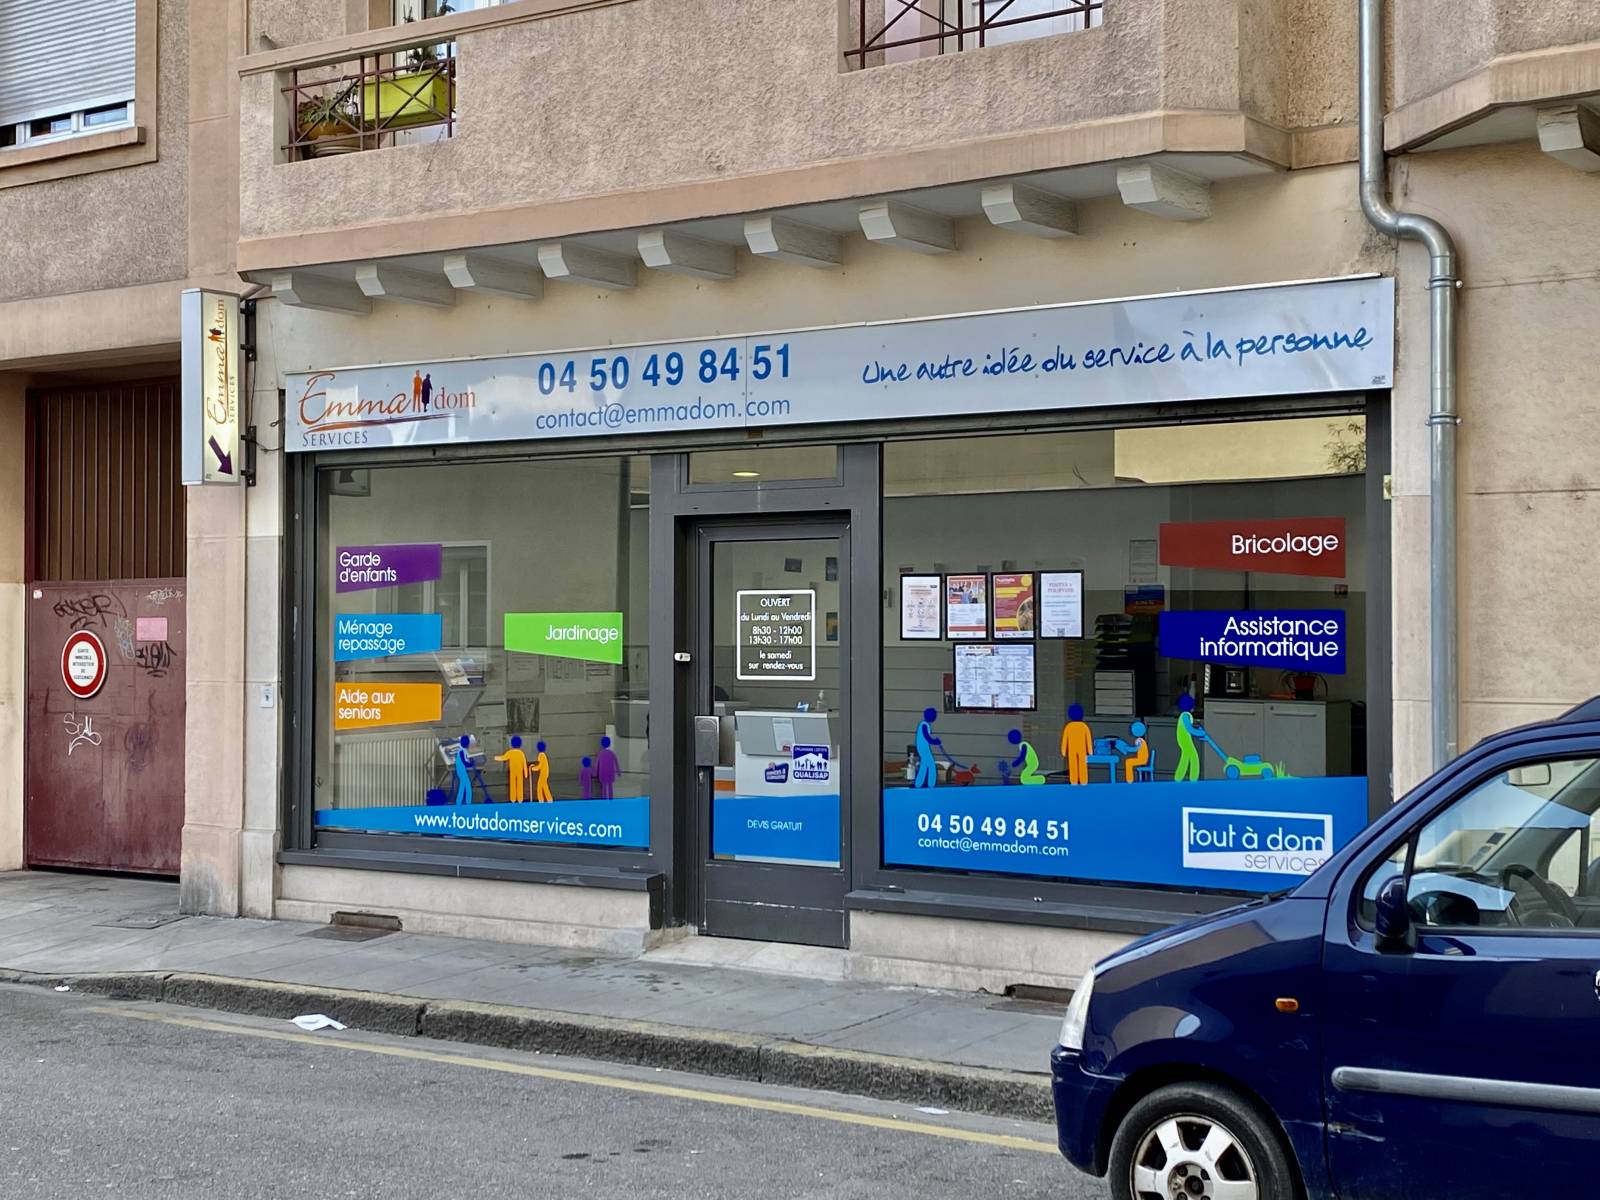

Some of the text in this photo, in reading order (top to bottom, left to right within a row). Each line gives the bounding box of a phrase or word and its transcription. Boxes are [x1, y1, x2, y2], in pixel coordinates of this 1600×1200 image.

[217, 299, 225, 329] dom
[862, 327, 1374, 384] Une autre idée du service à la personne
[537, 343, 790, 395] 04 50 49 84 51
[298, 371, 476, 425] Emma dom
[536, 396, 791, 429] contact@emmadom.com
[302, 431, 368, 447] SERVICES
[1231, 532, 1339, 556] Bricolage
[339, 552, 381, 567] Garde
[339, 567, 397, 583] d'enfants
[760, 598, 791, 607] OUVERT
[740, 612, 749, 621] du
[751, 612, 769, 621] Lundi
[781, 612, 811, 621] Vendredi
[338, 619, 393, 638] Ménage
[544, 625, 619, 644] Jardinage
[752, 626, 772, 635] 8h30
[779, 626, 803, 635] 12h00
[1223, 616, 1339, 636] Assistance
[338, 636, 406, 654] repassage
[749, 636, 772, 645] 13h30
[779, 636, 803, 645] 17h00
[1200, 637, 1339, 661] informatique
[759, 650, 792, 659] le samedi
[748, 661, 804, 670] sur rendez-vous
[338, 689, 395, 705] Aide aux
[338, 705, 382, 720] seniors
[794, 771, 828, 779] QUALISAP
[414, 811, 622, 838] www.toutadomservices.com
[747, 819, 803, 831] DEVIS GRATUIT
[917, 813, 1069, 840] 04 50 49 84 51
[1189, 821, 1325, 851] tout à dom
[918, 837, 1069, 857] contact@emmadom.com
